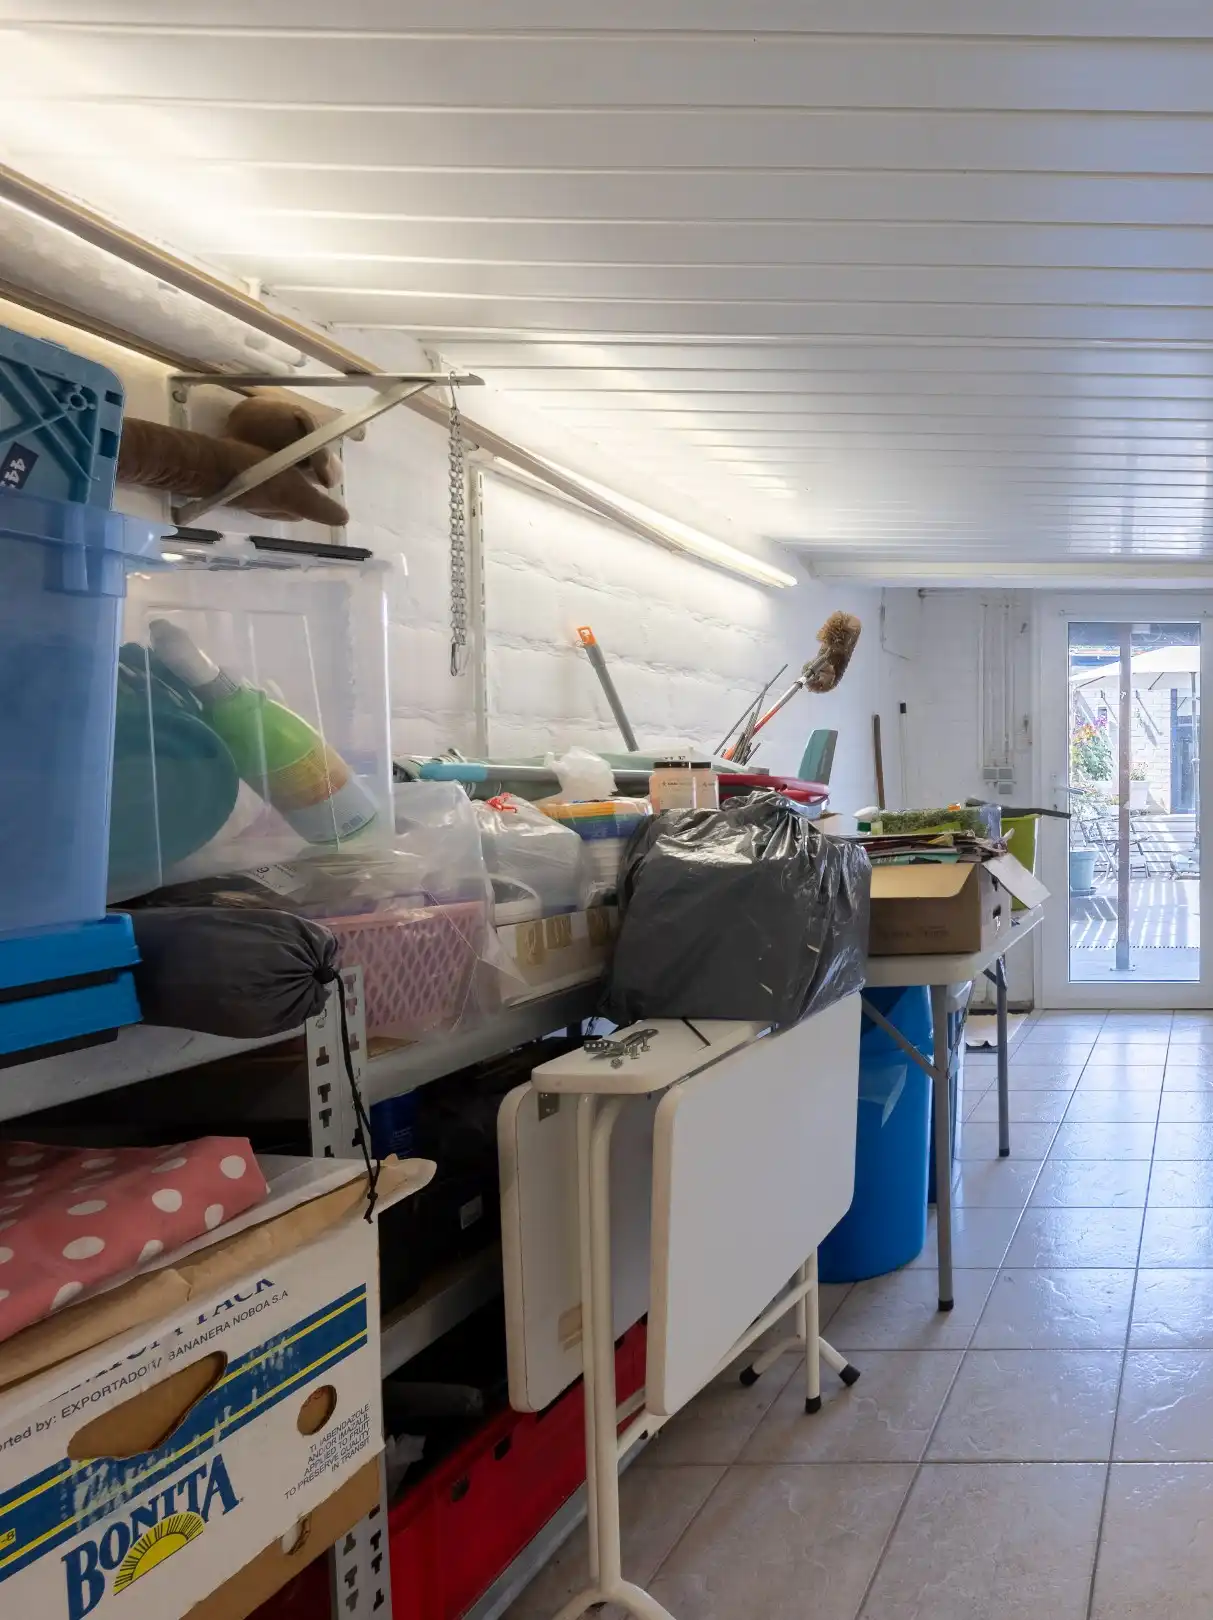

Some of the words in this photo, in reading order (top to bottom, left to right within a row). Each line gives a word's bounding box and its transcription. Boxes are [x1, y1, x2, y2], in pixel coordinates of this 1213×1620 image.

[35, 1415, 57, 1432] by:
[232, 1299, 270, 1327] NOBOA
[331, 1461, 340, 1473] IN
[340, 1435, 370, 1465] TRANSIT
[338, 1412, 370, 1442] IMAZALIL
[338, 1437, 348, 1449] TO
[349, 1419, 370, 1441] FRUIT
[284, 1487, 297, 1500] TO
[297, 1452, 339, 1492] PRESERVE
[340, 1427, 370, 1457] QUALITY
[61, 1453, 240, 1620] BONITA
